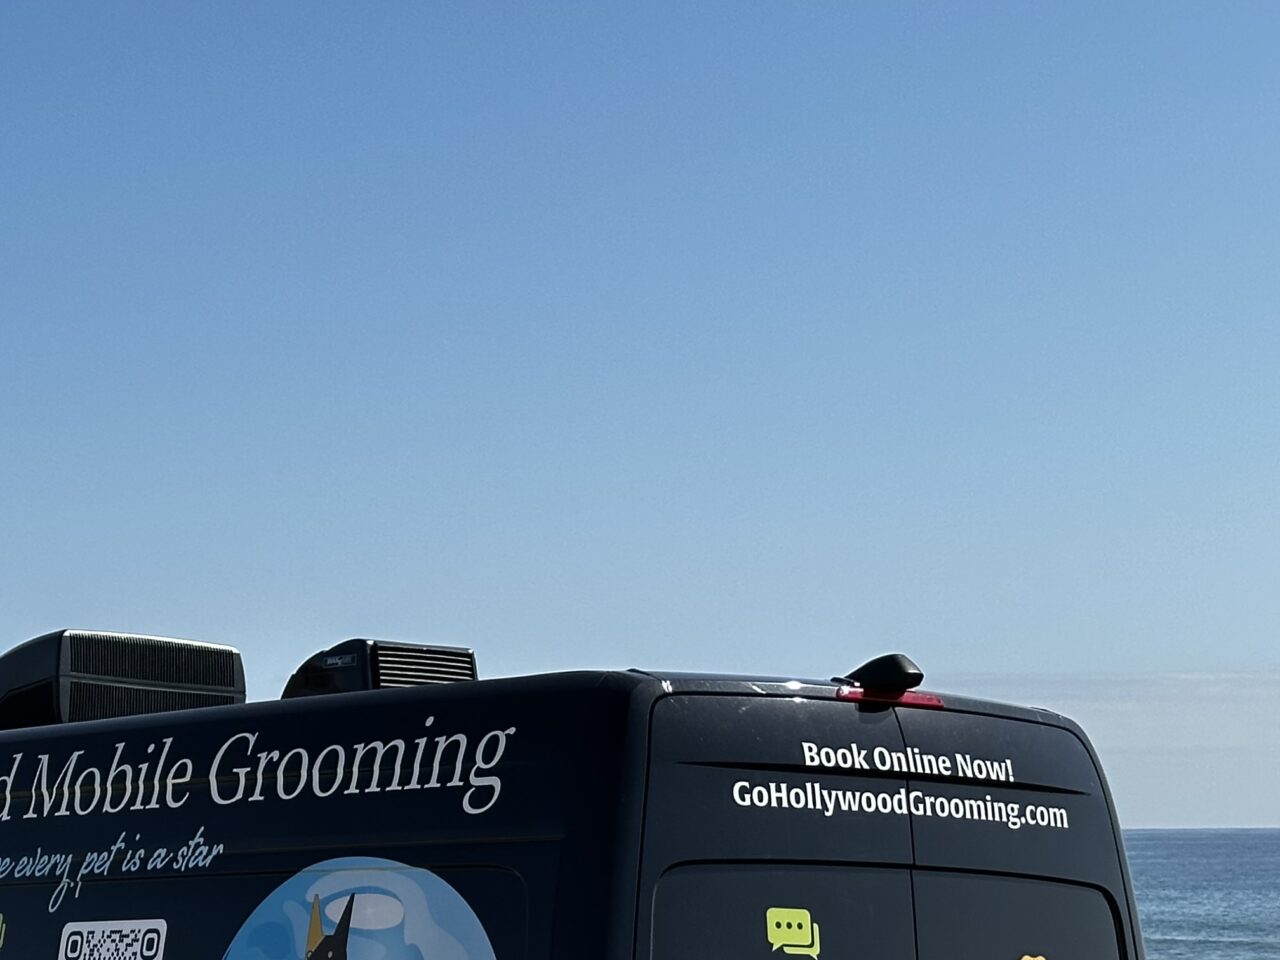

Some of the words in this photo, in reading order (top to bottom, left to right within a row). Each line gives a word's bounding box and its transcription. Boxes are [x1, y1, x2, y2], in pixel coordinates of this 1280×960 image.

[23, 737, 194, 820] Mobile
[209, 716, 516, 815] Grooming
[801, 741, 870, 770] Book
[873, 746, 952, 776] Online
[954, 753, 1015, 782] Now!
[731, 780, 1070, 829] GoHollywoodGrooming.com
[15, 847, 73, 913] every
[74, 832, 125, 899] pet
[122, 833, 144, 872] is
[147, 846, 173, 871] a
[173, 826, 224, 872] star
